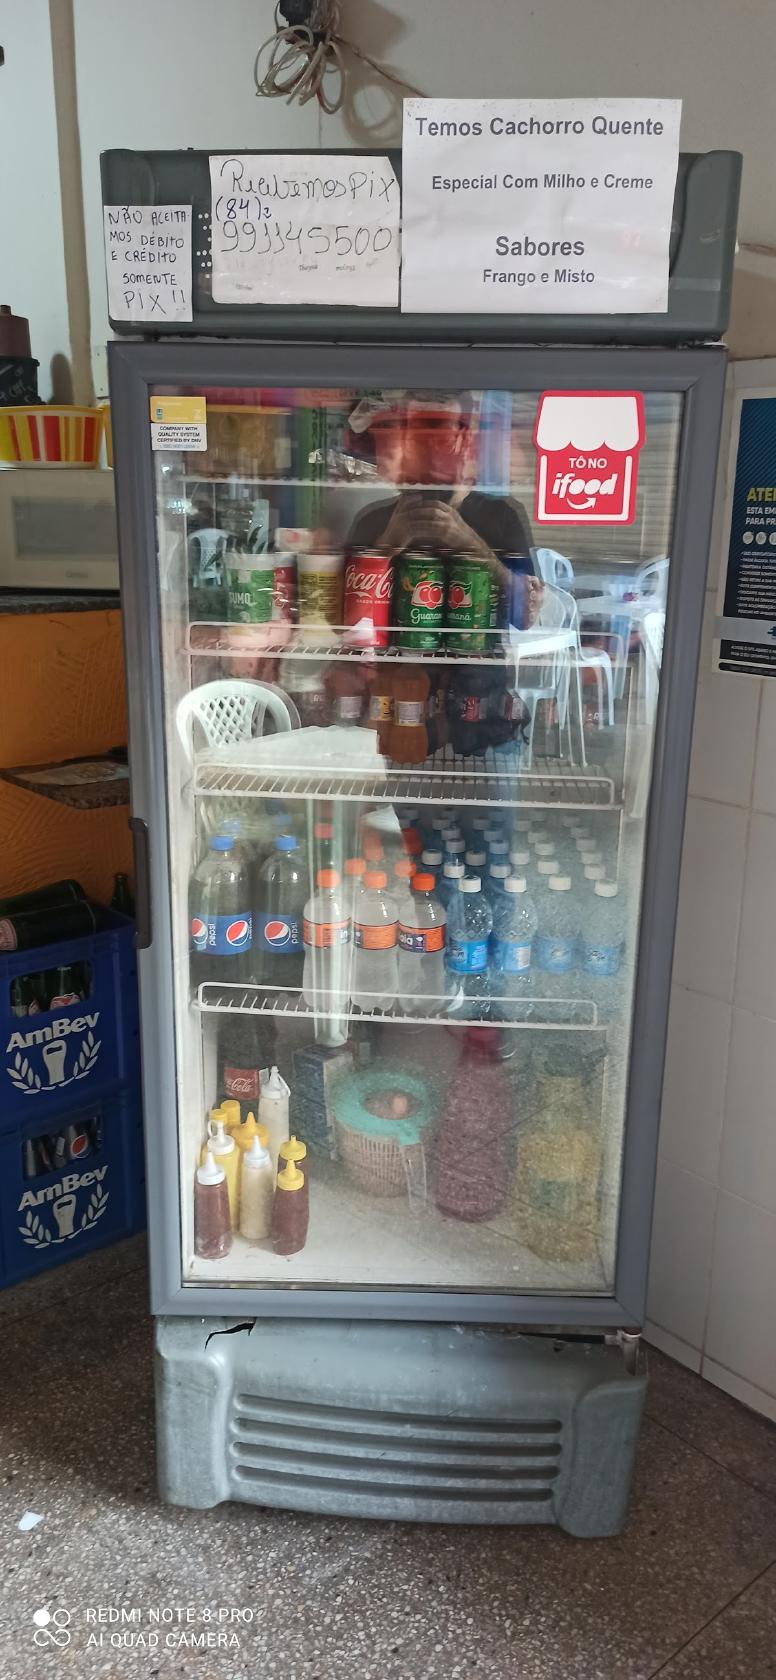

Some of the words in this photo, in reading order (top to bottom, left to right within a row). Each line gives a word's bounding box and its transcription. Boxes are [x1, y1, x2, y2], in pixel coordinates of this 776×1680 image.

[415, 117, 483, 136] Temos
[490, 117, 585, 136] Cachorro
[592, 115, 664, 136] Quente
[432, 174, 498, 192] Especial
[503, 174, 538, 189] Com
[543, 173, 585, 189] Milho
[590, 178, 599, 189] e
[604, 173, 654, 189] Creme
[108, 206, 143, 225] NÃO
[109, 230, 132, 243] MOS
[140, 231, 185, 249] DÉBITO
[495, 235, 585, 257] Sabores
[111, 250, 118, 261] E
[124, 247, 177, 263] CRÉDITO
[122, 272, 178, 286] SOMENTE
[483, 269, 536, 287] Frango
[540, 272, 550, 284] e
[554, 269, 596, 284] Misto
[122, 290, 167, 315] PIX
[568, 455, 586, 469] TÔ
[587, 457, 608, 469] NO
[552, 473, 618, 499] ifood
[746, 487, 776, 502] ATE
[746, 506, 764, 515] ESTA
[745, 517, 765, 525] PARA
[6, 1011, 101, 1053] AmBev
[17, 1164, 109, 1212] AmBev
